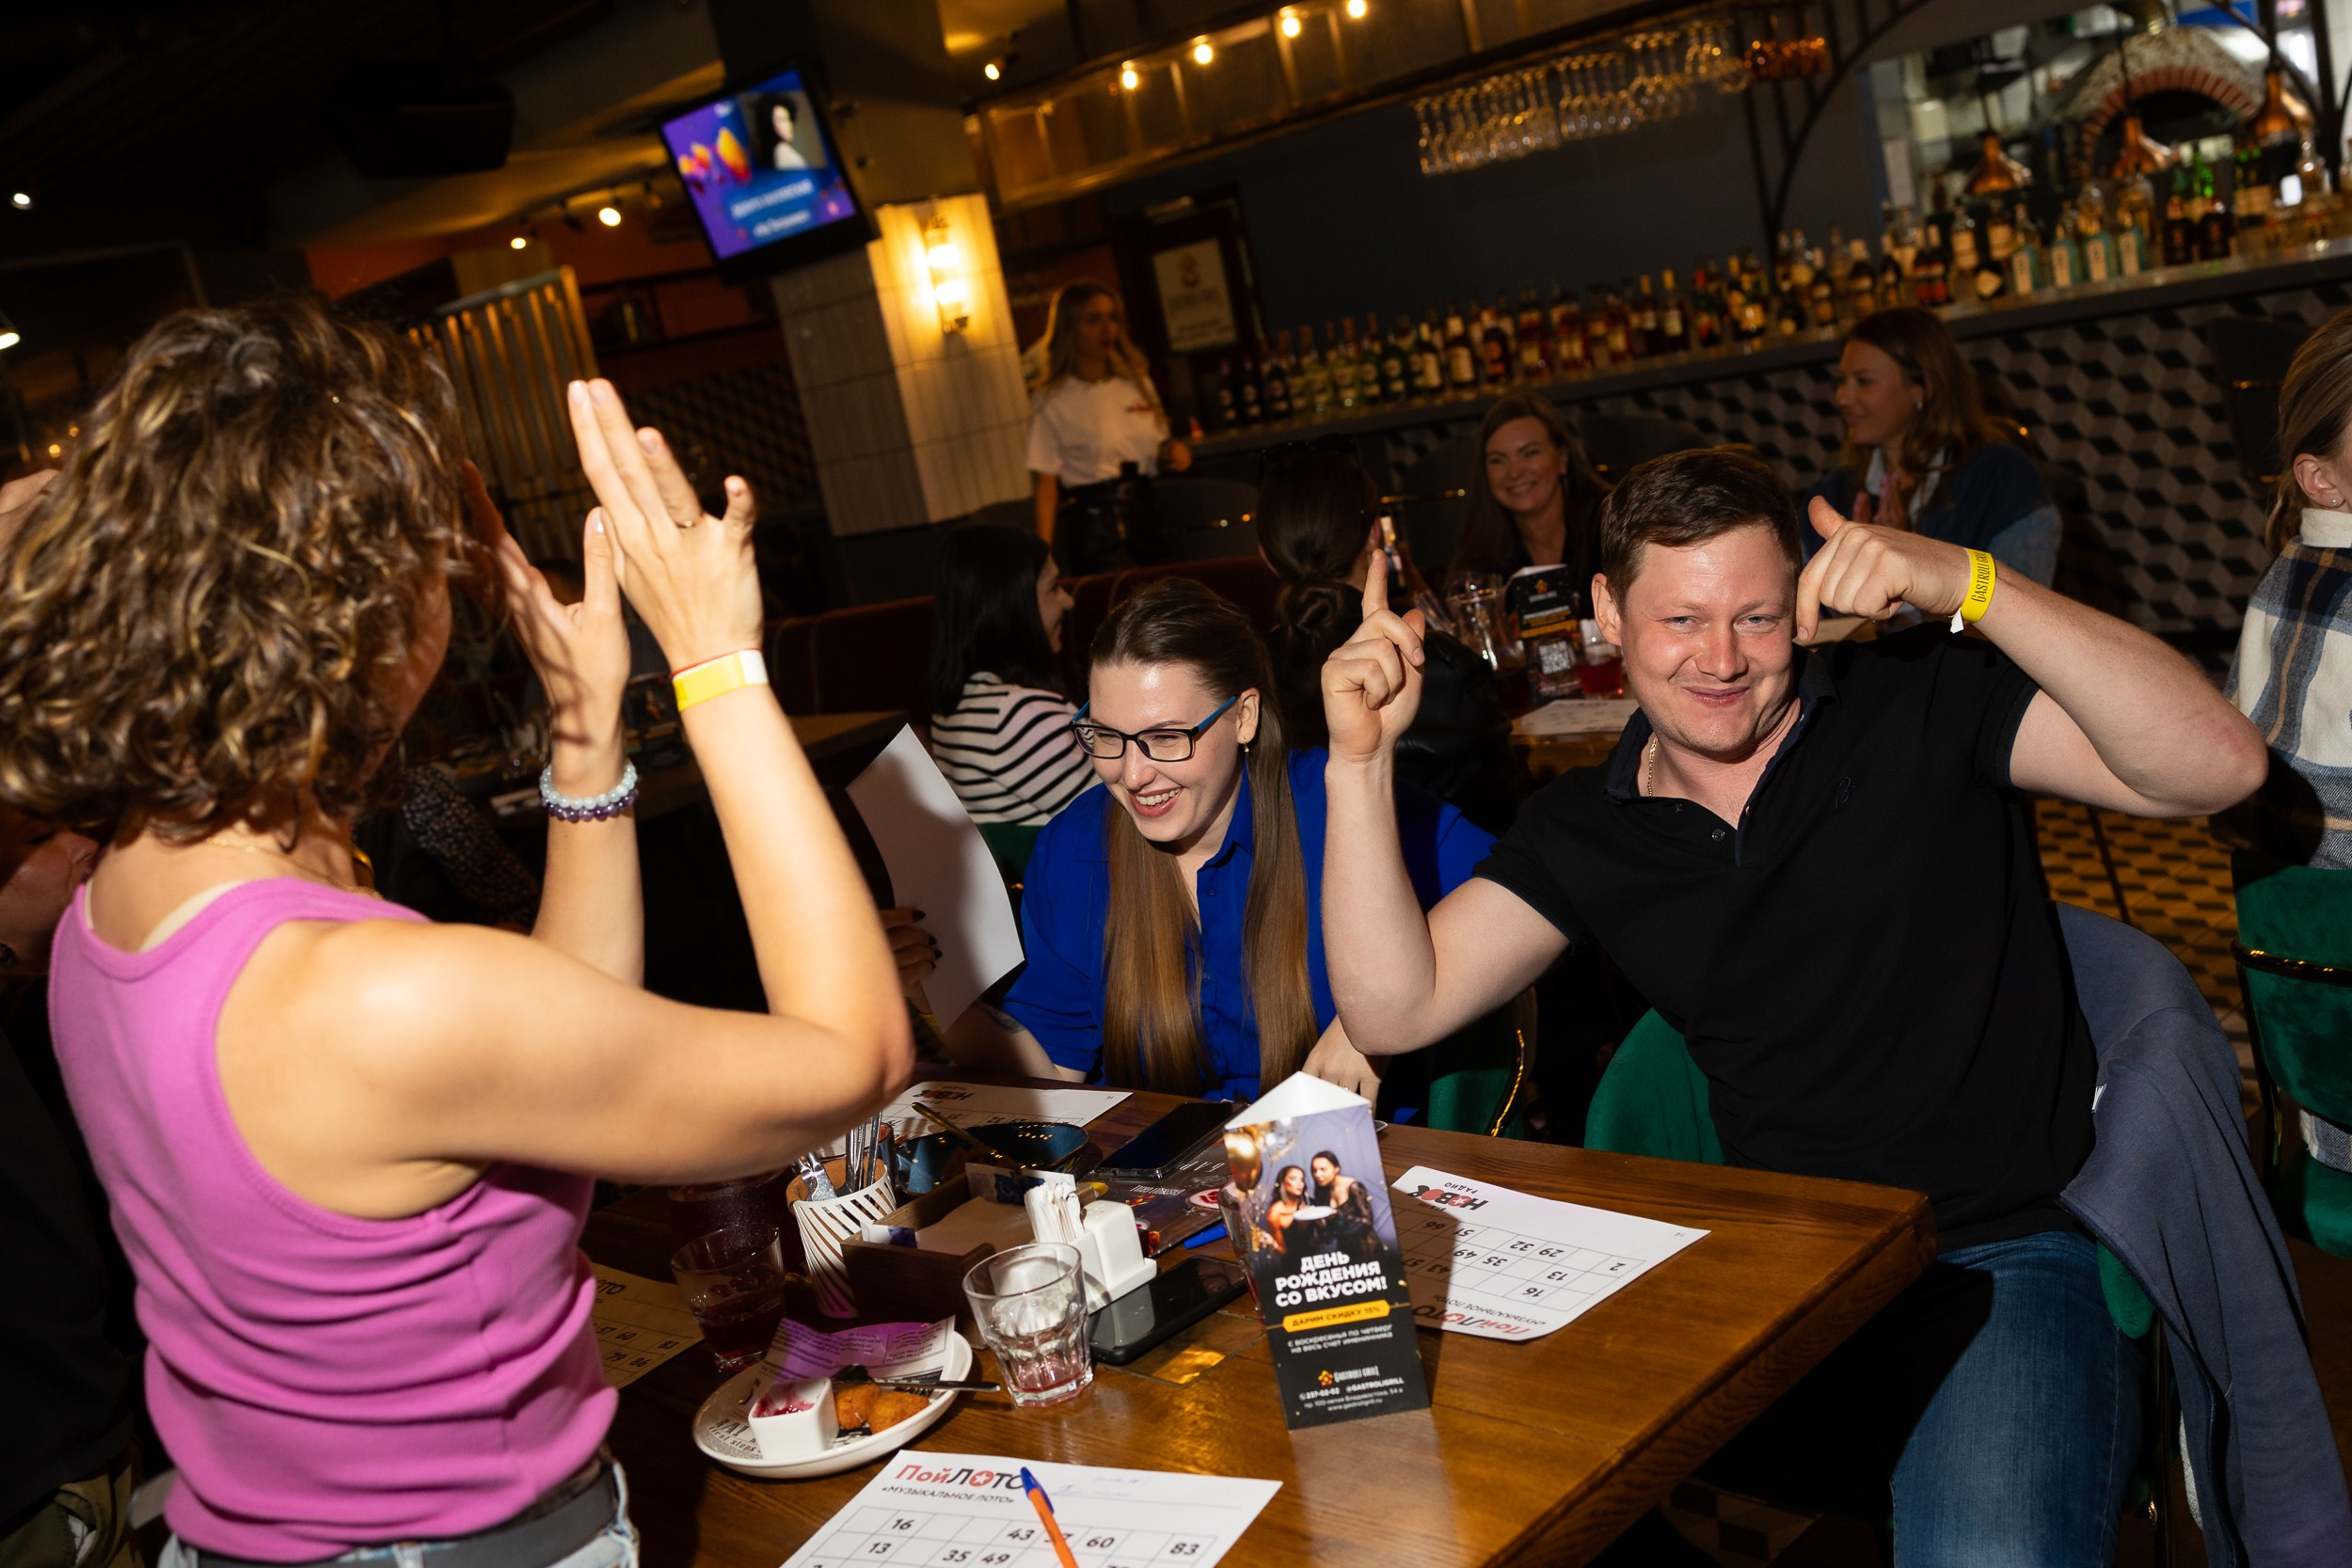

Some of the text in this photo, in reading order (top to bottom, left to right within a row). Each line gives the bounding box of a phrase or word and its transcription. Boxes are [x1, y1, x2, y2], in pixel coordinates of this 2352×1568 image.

[1444, 1182, 1478, 1195] РАДИО
[1422, 1221, 1626, 1271] 2 29 32 51 66
[1300, 1251, 1350, 1273] ДЕНЬ
[1454, 1249, 1567, 1280] 13 35 49
[1275, 1260, 1381, 1291] РОЖДЕНИЯ
[1403, 1259, 1545, 1298] 16 43 57
[1275, 1275, 1388, 1307] СО ВКУСОМ!
[1293, 1316, 1324, 1327] ДАРИМ
[1326, 1309, 1362, 1322] СКИДКУ
[616, 1332, 637, 1340] 60
[658, 1340, 679, 1350] 83
[1302, 1343, 1323, 1353] ВЕСЬ
[605, 1352, 652, 1367] 79 86
[892, 1518, 914, 1531] 16
[1007, 1528, 1035, 1541] 43
[1087, 1535, 1115, 1548] 60
[1170, 1543, 1200, 1557] 83
[868, 1542, 1010, 1565] 13 35 49
